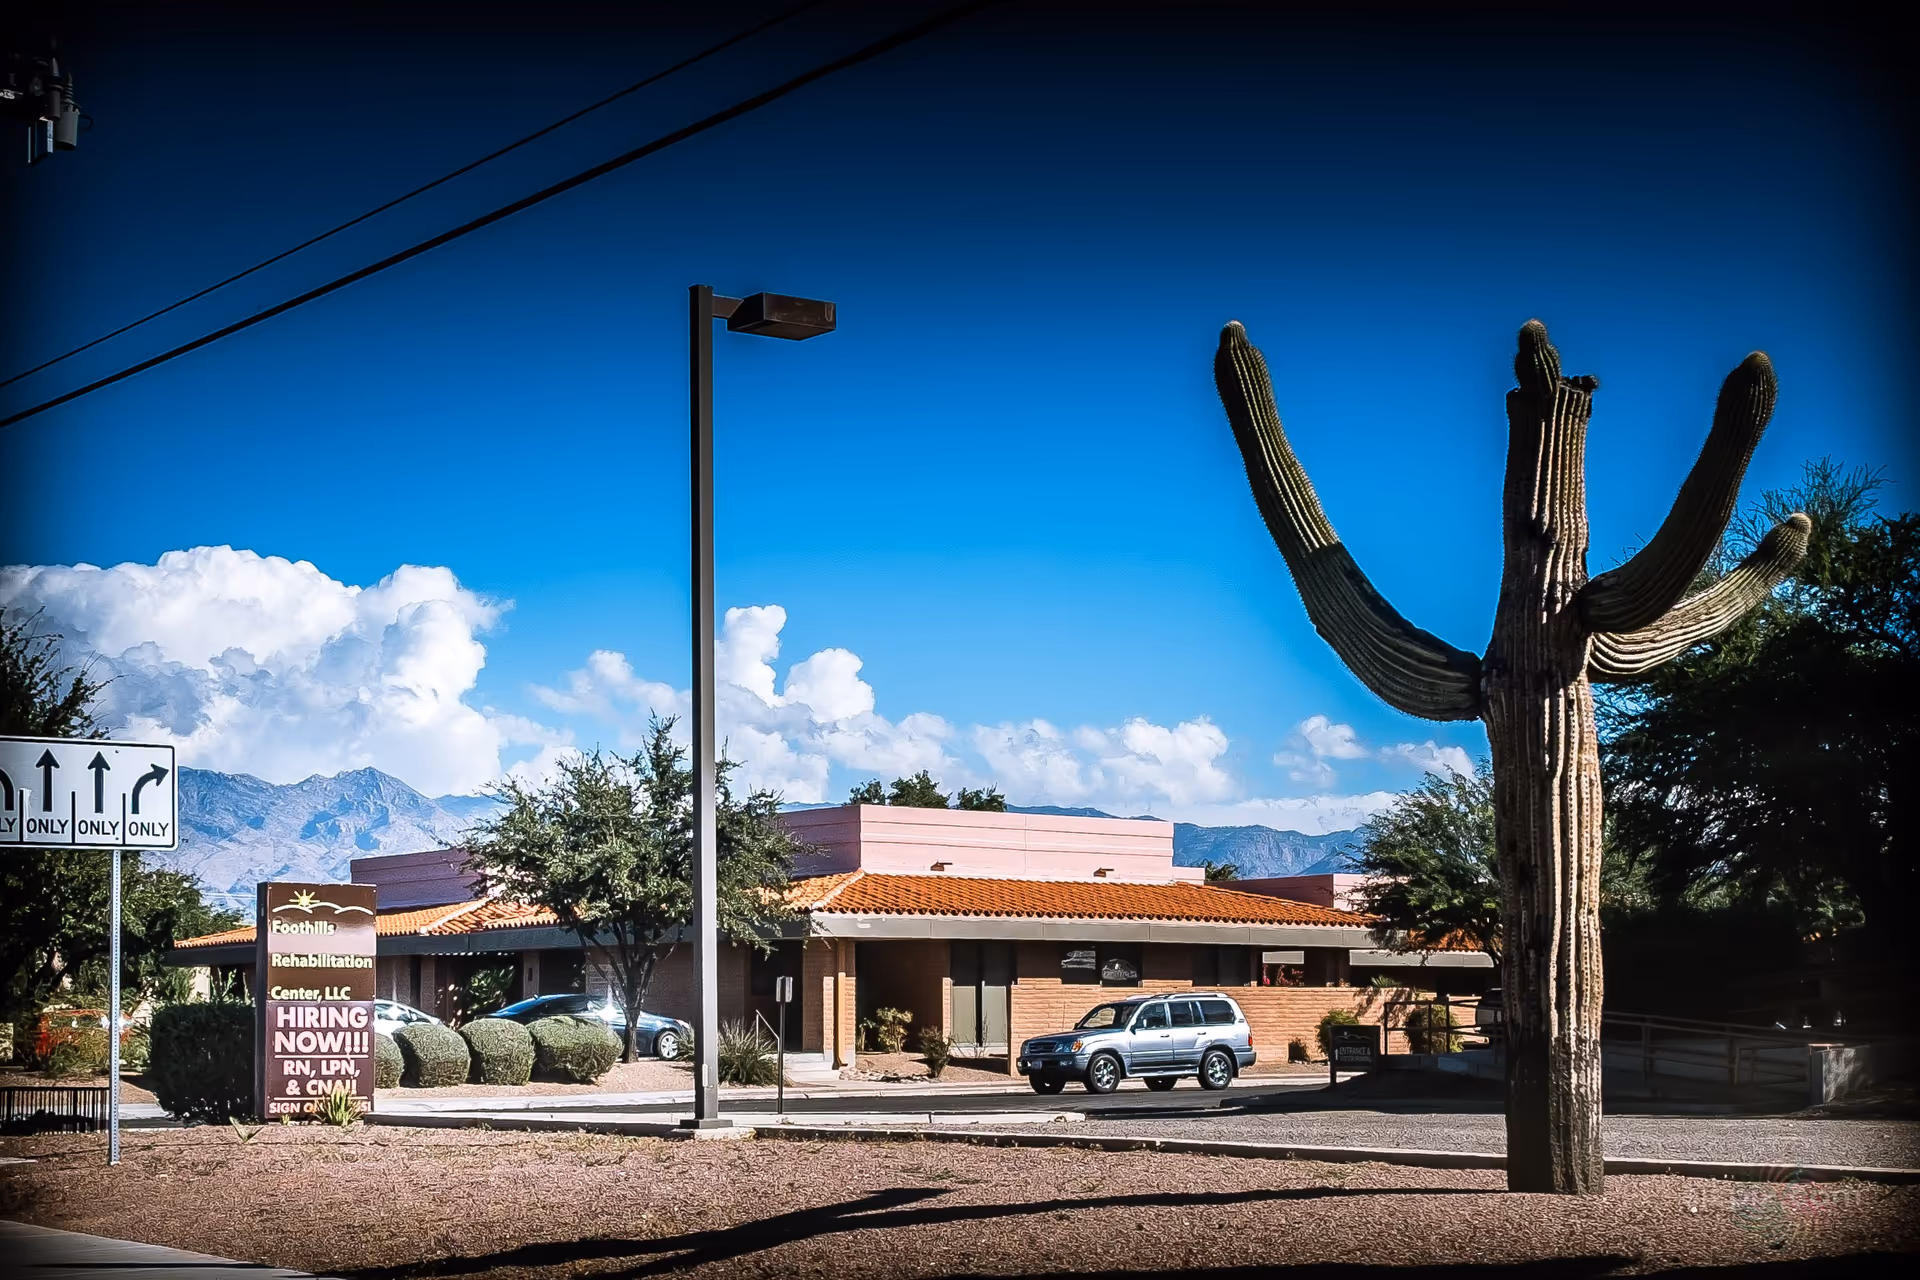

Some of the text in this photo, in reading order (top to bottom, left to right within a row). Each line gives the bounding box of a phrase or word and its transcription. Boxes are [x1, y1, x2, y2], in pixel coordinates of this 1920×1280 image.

[0, 818, 18, 833] LY
[26, 818, 69, 834] ONLY
[78, 820, 120, 836] ONLY
[128, 822, 169, 837] ONLY
[272, 920, 335, 935] Foothills
[271, 953, 373, 968] Rehabilitation
[270, 985, 351, 1003] Center, LLC
[277, 1006, 368, 1028] HIRING
[274, 1031, 369, 1053] NOW!!!
[283, 1060, 361, 1078] RN, LPN,
[285, 1079, 301, 1095] &
[269, 1102, 301, 1114] SIGN
